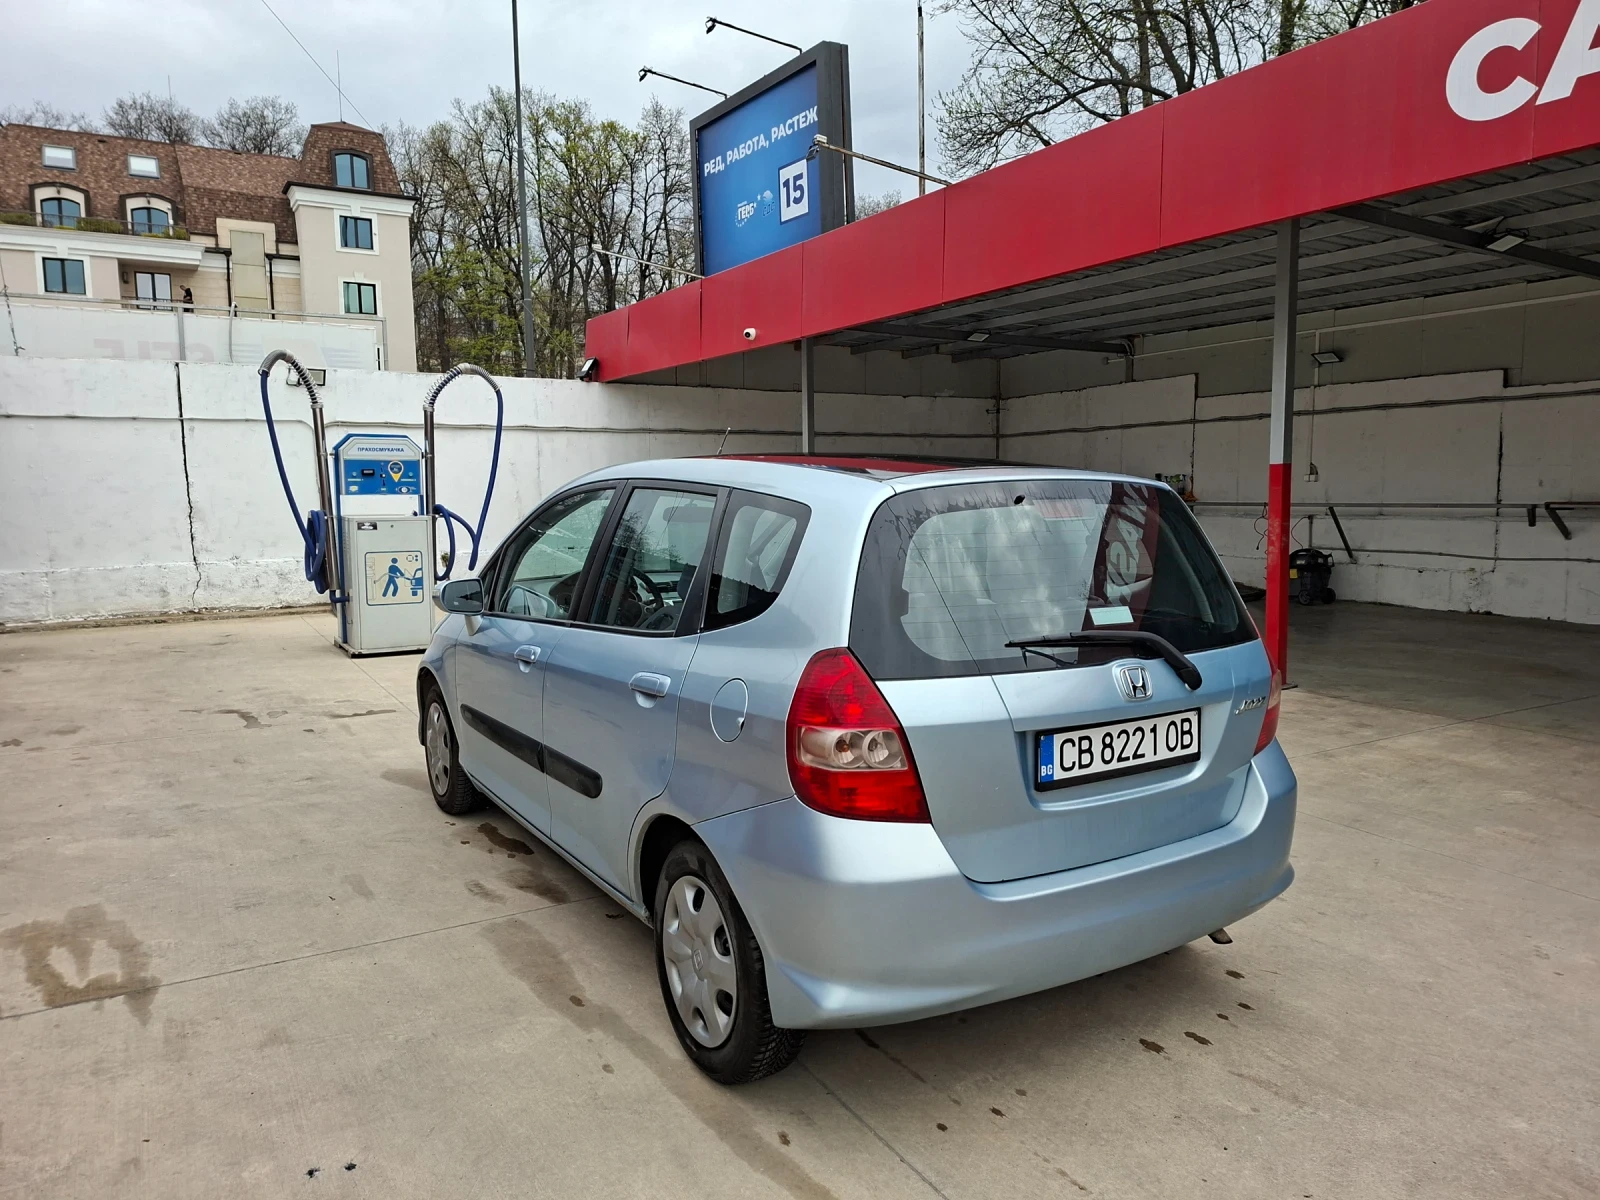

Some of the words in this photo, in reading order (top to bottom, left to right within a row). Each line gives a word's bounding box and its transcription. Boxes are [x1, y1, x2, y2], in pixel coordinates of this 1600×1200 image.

[704, 156, 725, 176] РЕД,
[727, 134, 769, 165] РАБОТА,
[771, 106, 818, 142] РАСТЕЖ
[783, 172, 805, 208] 15
[738, 203, 754, 220] ГЕРБ
[1059, 735, 1094, 772] CB
[1101, 724, 1158, 765] 8221
[1165, 717, 1193, 752] OB
[1041, 765, 1053, 776] BG
